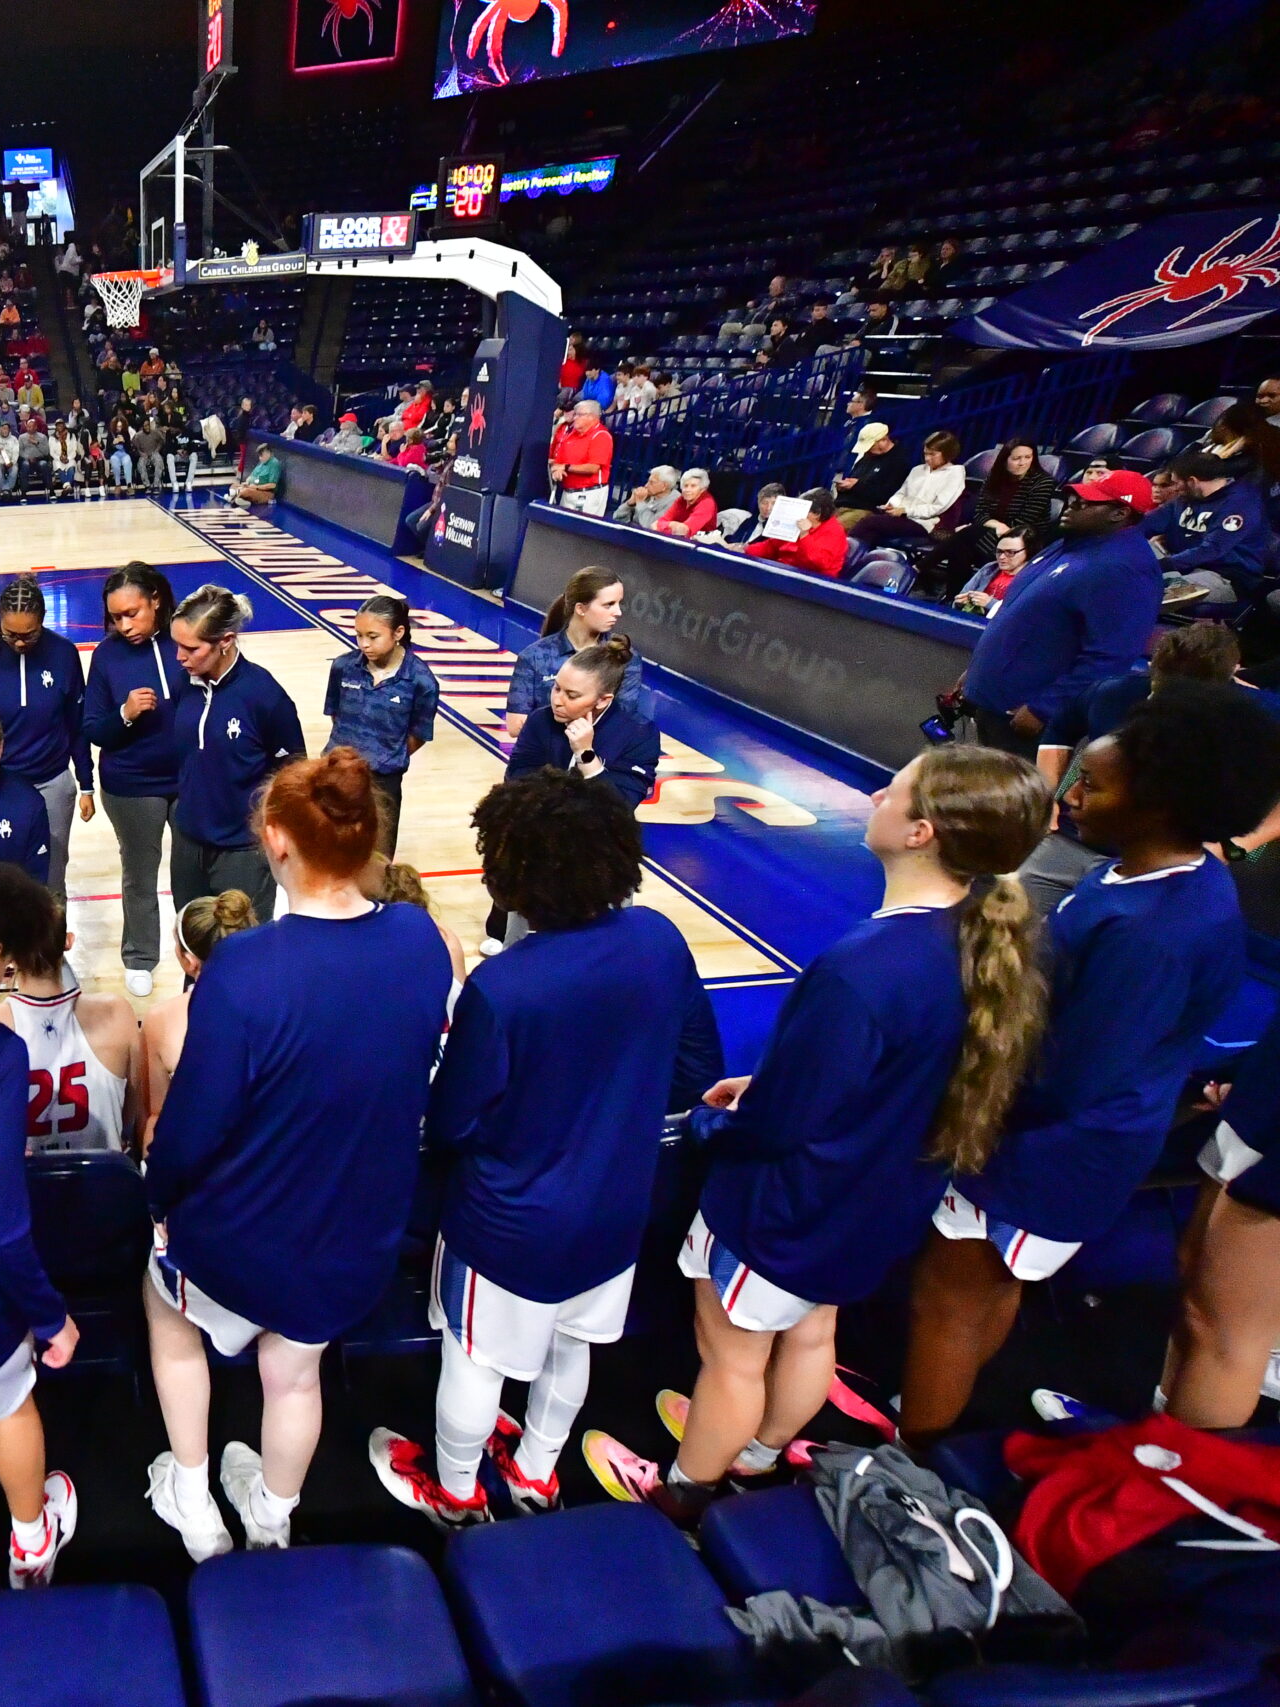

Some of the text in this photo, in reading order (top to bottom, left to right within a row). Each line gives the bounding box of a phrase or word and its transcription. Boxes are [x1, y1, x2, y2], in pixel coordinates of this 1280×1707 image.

[452, 164, 495, 187] 10:00
[530, 172, 573, 188] Personal
[454, 186, 483, 216] 20
[320, 217, 382, 234] FLOOR
[319, 233, 380, 249] DECOR
[448, 512, 476, 533] SHERWIN
[170, 508, 408, 600] RICHMOND
[27, 1061, 89, 1137] 25
